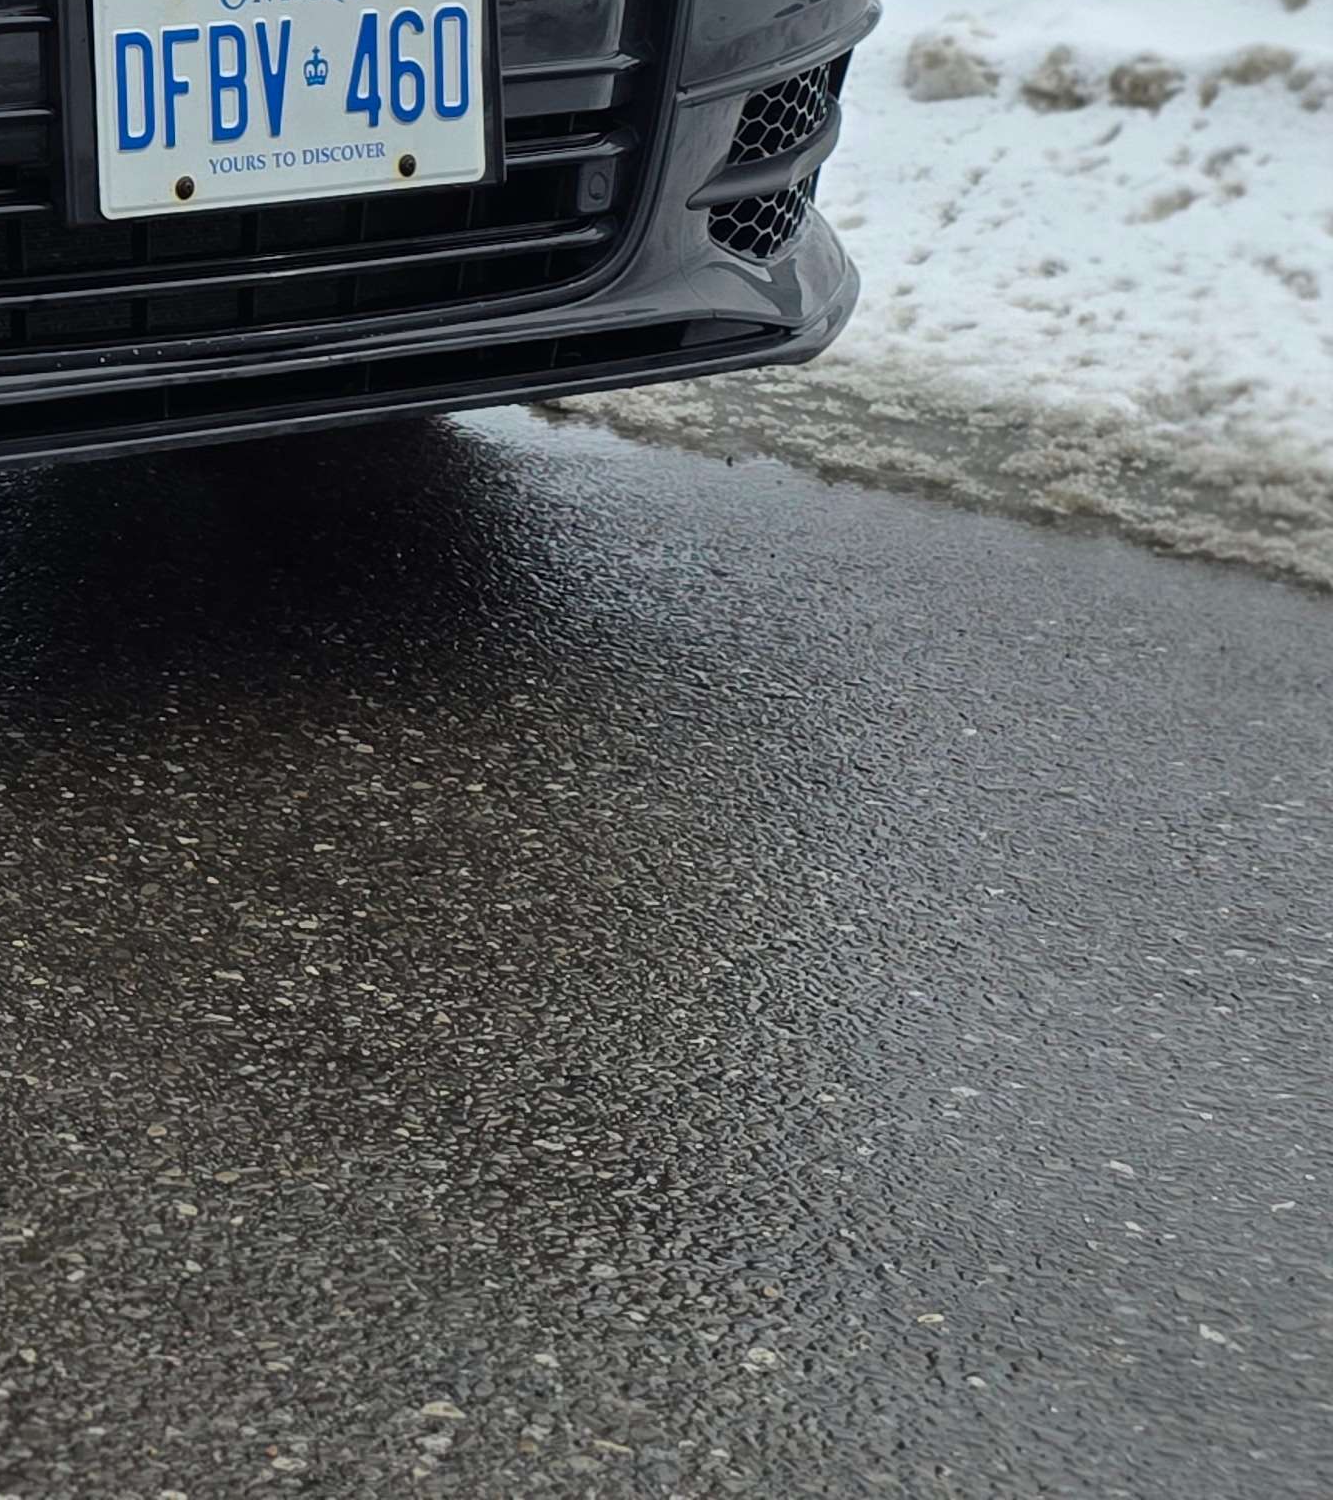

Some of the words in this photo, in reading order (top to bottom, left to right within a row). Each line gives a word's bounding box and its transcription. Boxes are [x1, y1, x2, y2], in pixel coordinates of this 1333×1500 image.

[114, 18, 292, 151] DFBV
[345, 5, 469, 128] 460
[208, 154, 266, 175] YOURS
[272, 151, 297, 168] TO
[302, 141, 386, 165] DISCOVER
